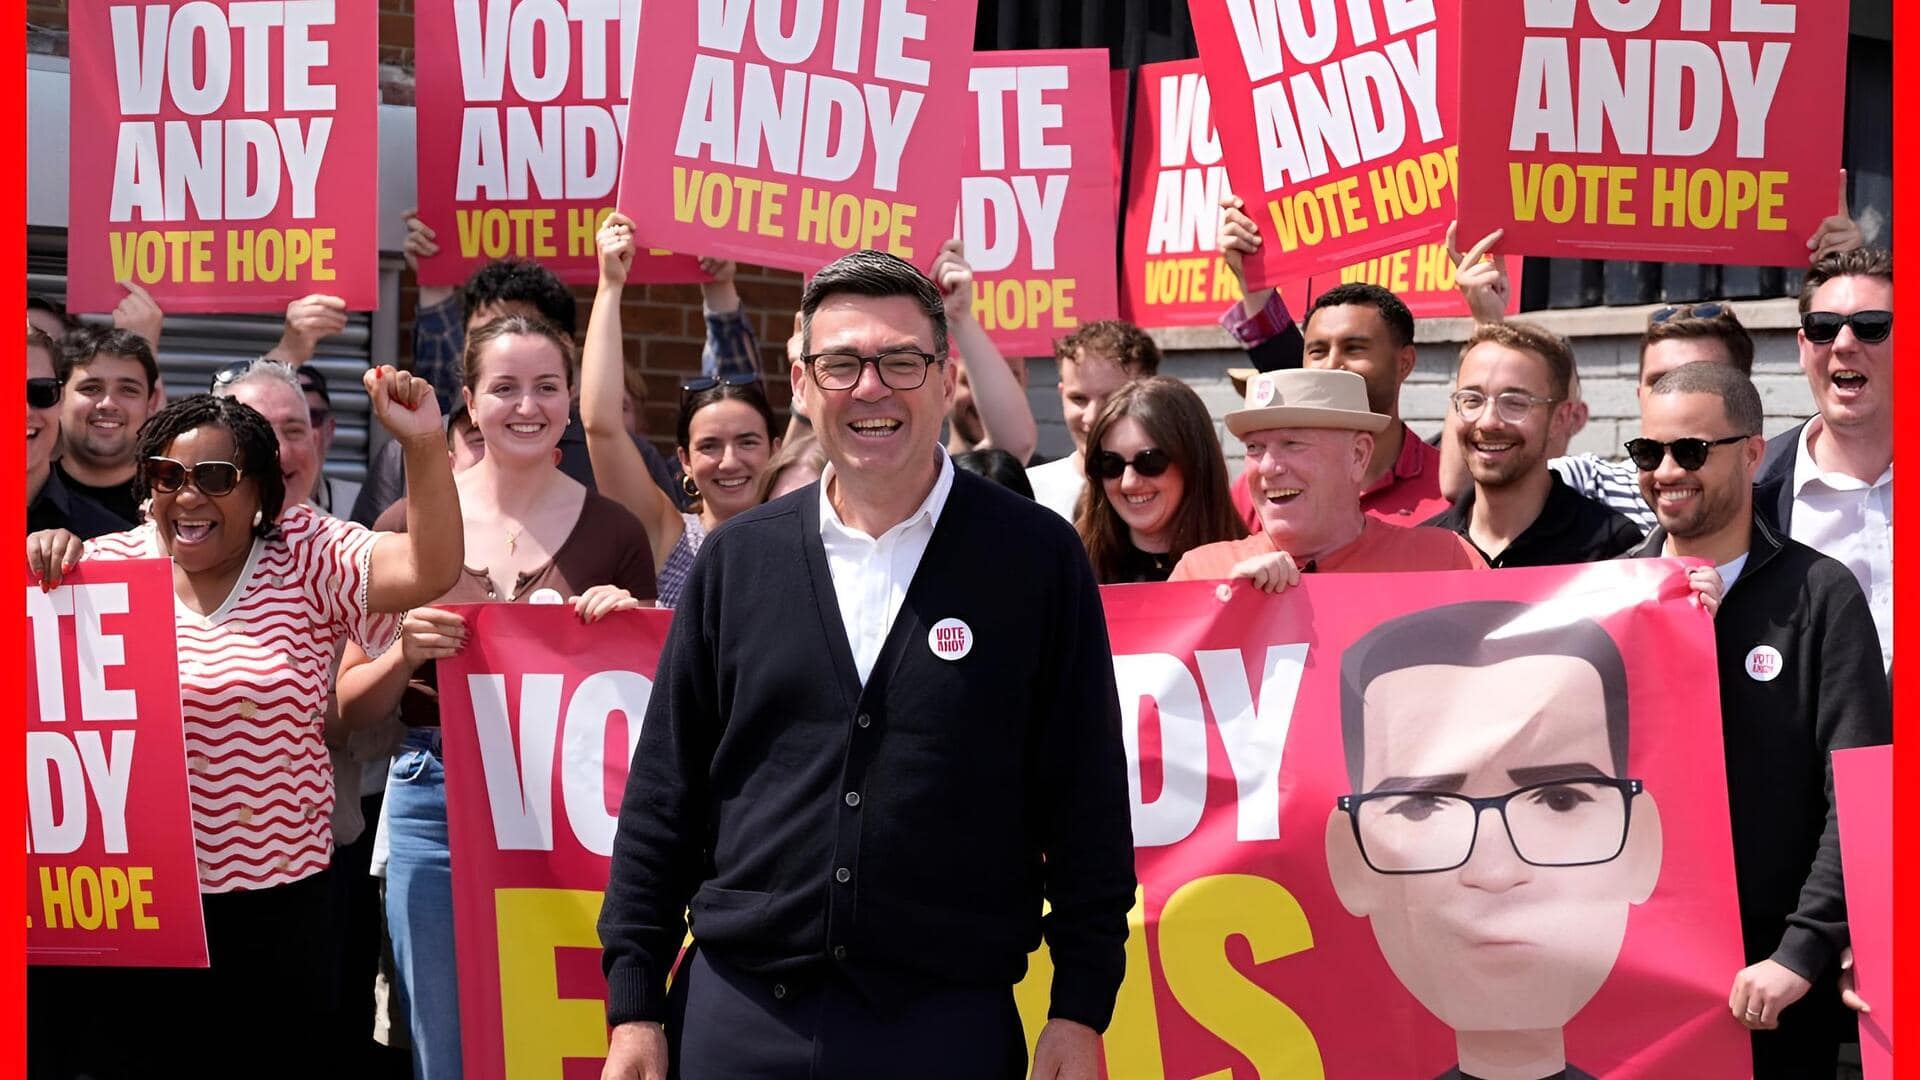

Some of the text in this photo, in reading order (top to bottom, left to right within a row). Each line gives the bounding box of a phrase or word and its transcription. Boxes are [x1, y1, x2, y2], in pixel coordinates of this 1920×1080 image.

[110, 0, 336, 115] VOTE
[1509, 36, 1792, 158] ANDY
[674, 53, 926, 192] ANDY
[968, 66, 1072, 170] TE
[1160, 74, 1223, 168] VO
[1252, 29, 1444, 193] ANDY
[109, 117, 333, 222] ANDY
[673, 166, 788, 238] VOTE
[797, 187, 917, 259] HOPE
[1146, 166, 1233, 255] AN
[1268, 176, 1368, 251] VOTE
[1509, 162, 1789, 231] VOTE HOPE
[109, 228, 336, 284] VOTE HOPE
[456, 209, 557, 258] VOTE
[961, 174, 1069, 272] DY
[971, 278, 1078, 331] HOPE
[1145, 257, 1209, 304] VOTE
[27, 582, 138, 722] TE
[936, 626, 965, 641] VOTE
[26, 730, 136, 854] DY
[467, 642, 1310, 856] VO DY
[39, 866, 160, 930] HOPE
